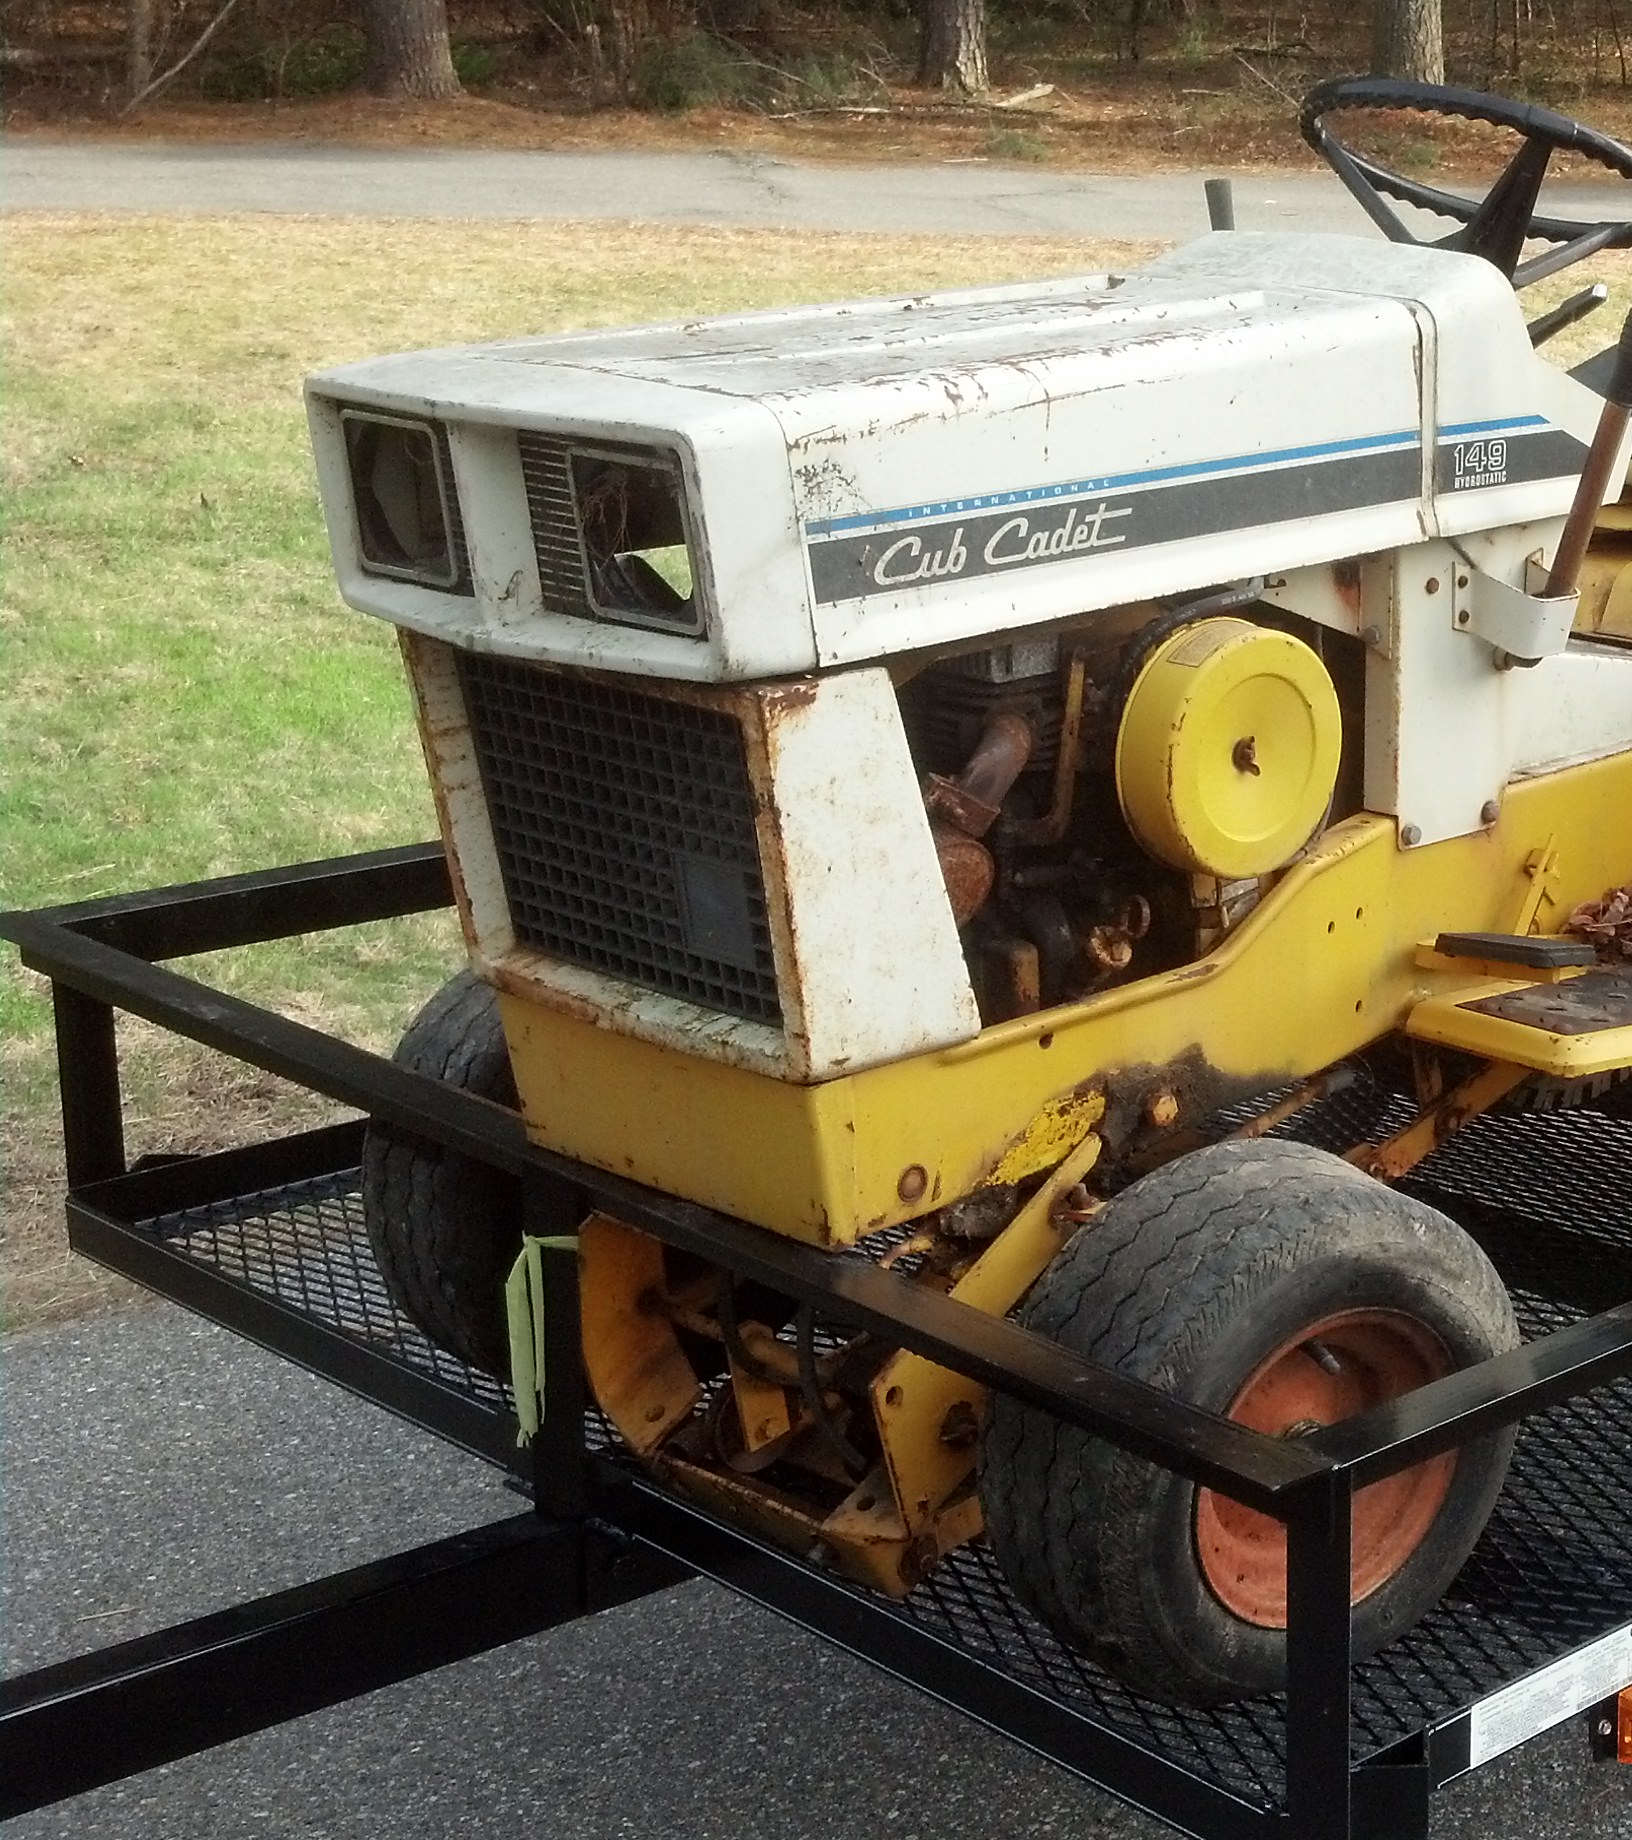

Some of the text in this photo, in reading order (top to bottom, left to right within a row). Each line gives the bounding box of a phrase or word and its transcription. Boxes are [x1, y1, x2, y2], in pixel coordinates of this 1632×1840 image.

[1454, 440, 1507, 475] 149
[908, 479, 1110, 517] INTERNATIONAL
[873, 502, 1133, 586] Cub Cadet
